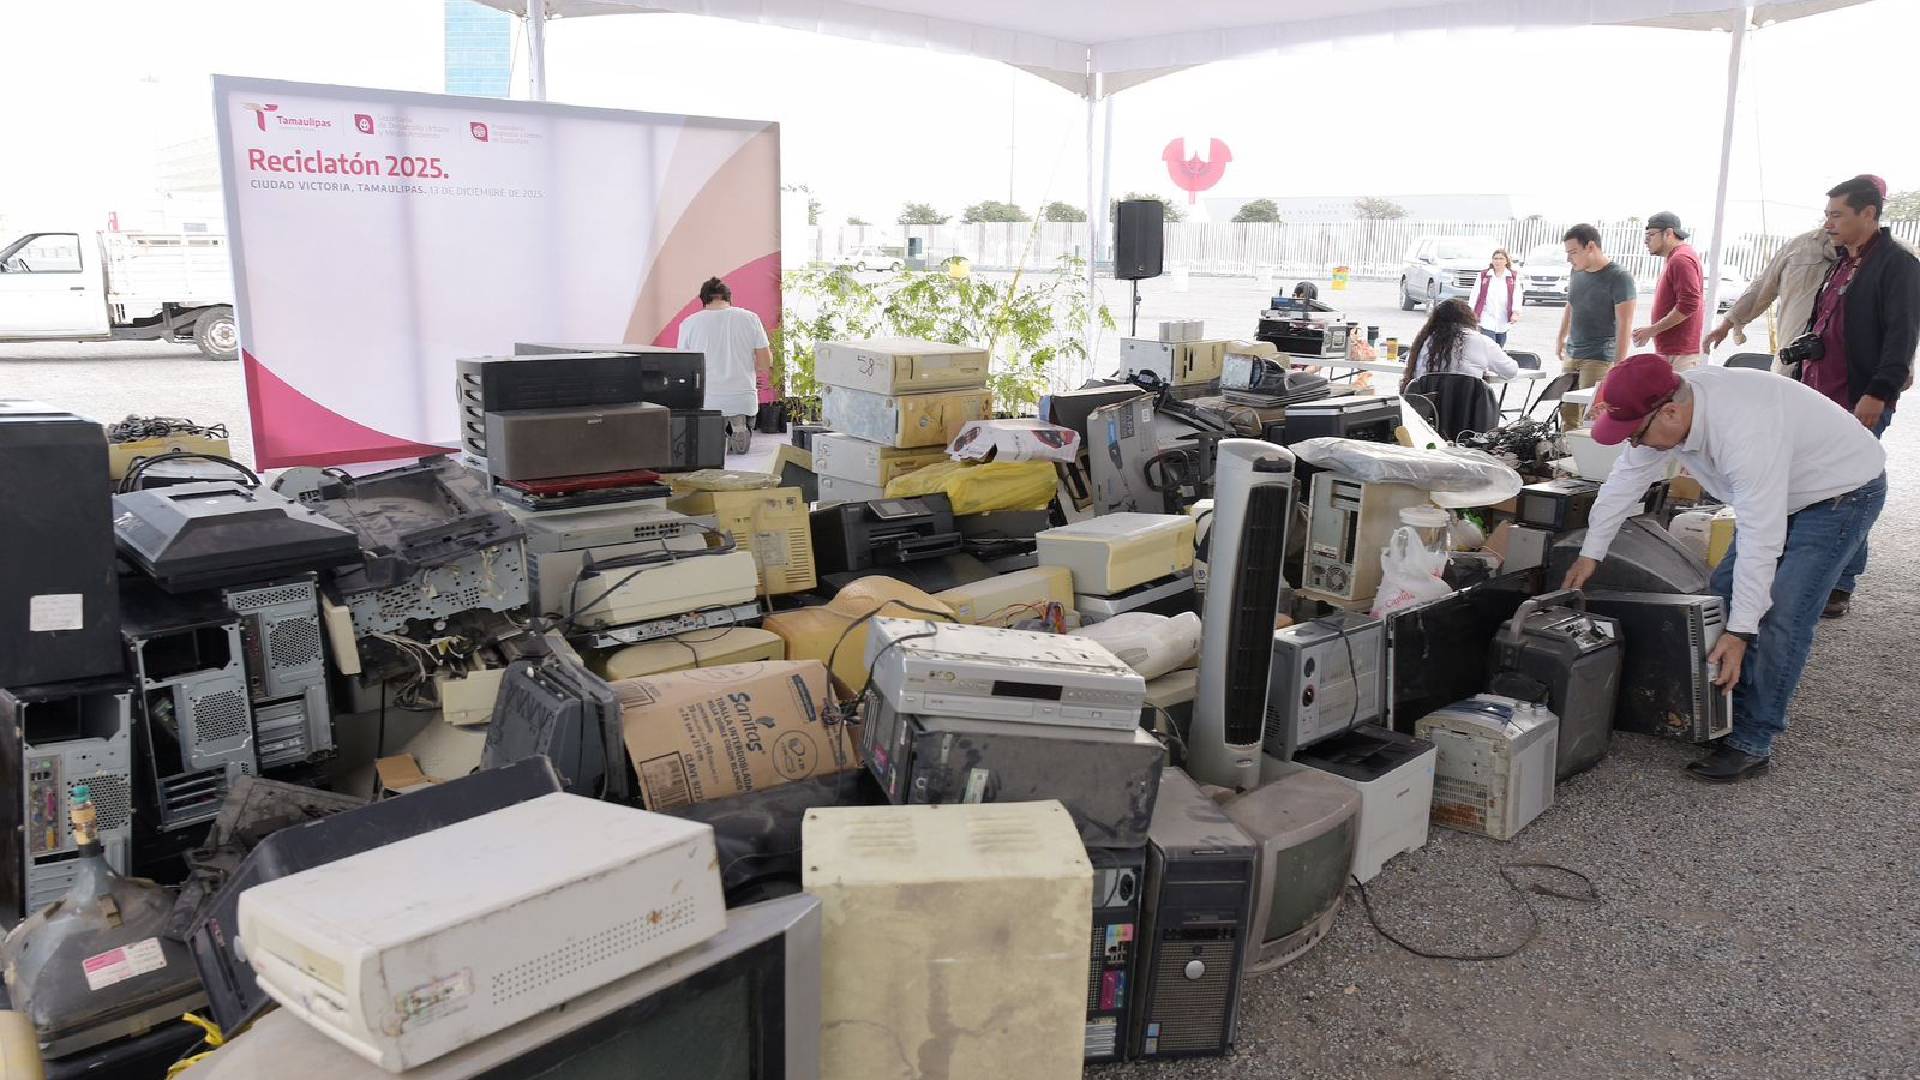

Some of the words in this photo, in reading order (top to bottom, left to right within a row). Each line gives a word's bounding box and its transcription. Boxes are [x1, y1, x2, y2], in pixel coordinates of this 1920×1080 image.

[276, 114, 332, 128] Tamaulipas
[248, 148, 379, 175] Reciclatón
[385, 155, 449, 179] 2025.
[250, 179, 295, 189] CIUDAD
[728, 692, 763, 752] Sanitas
